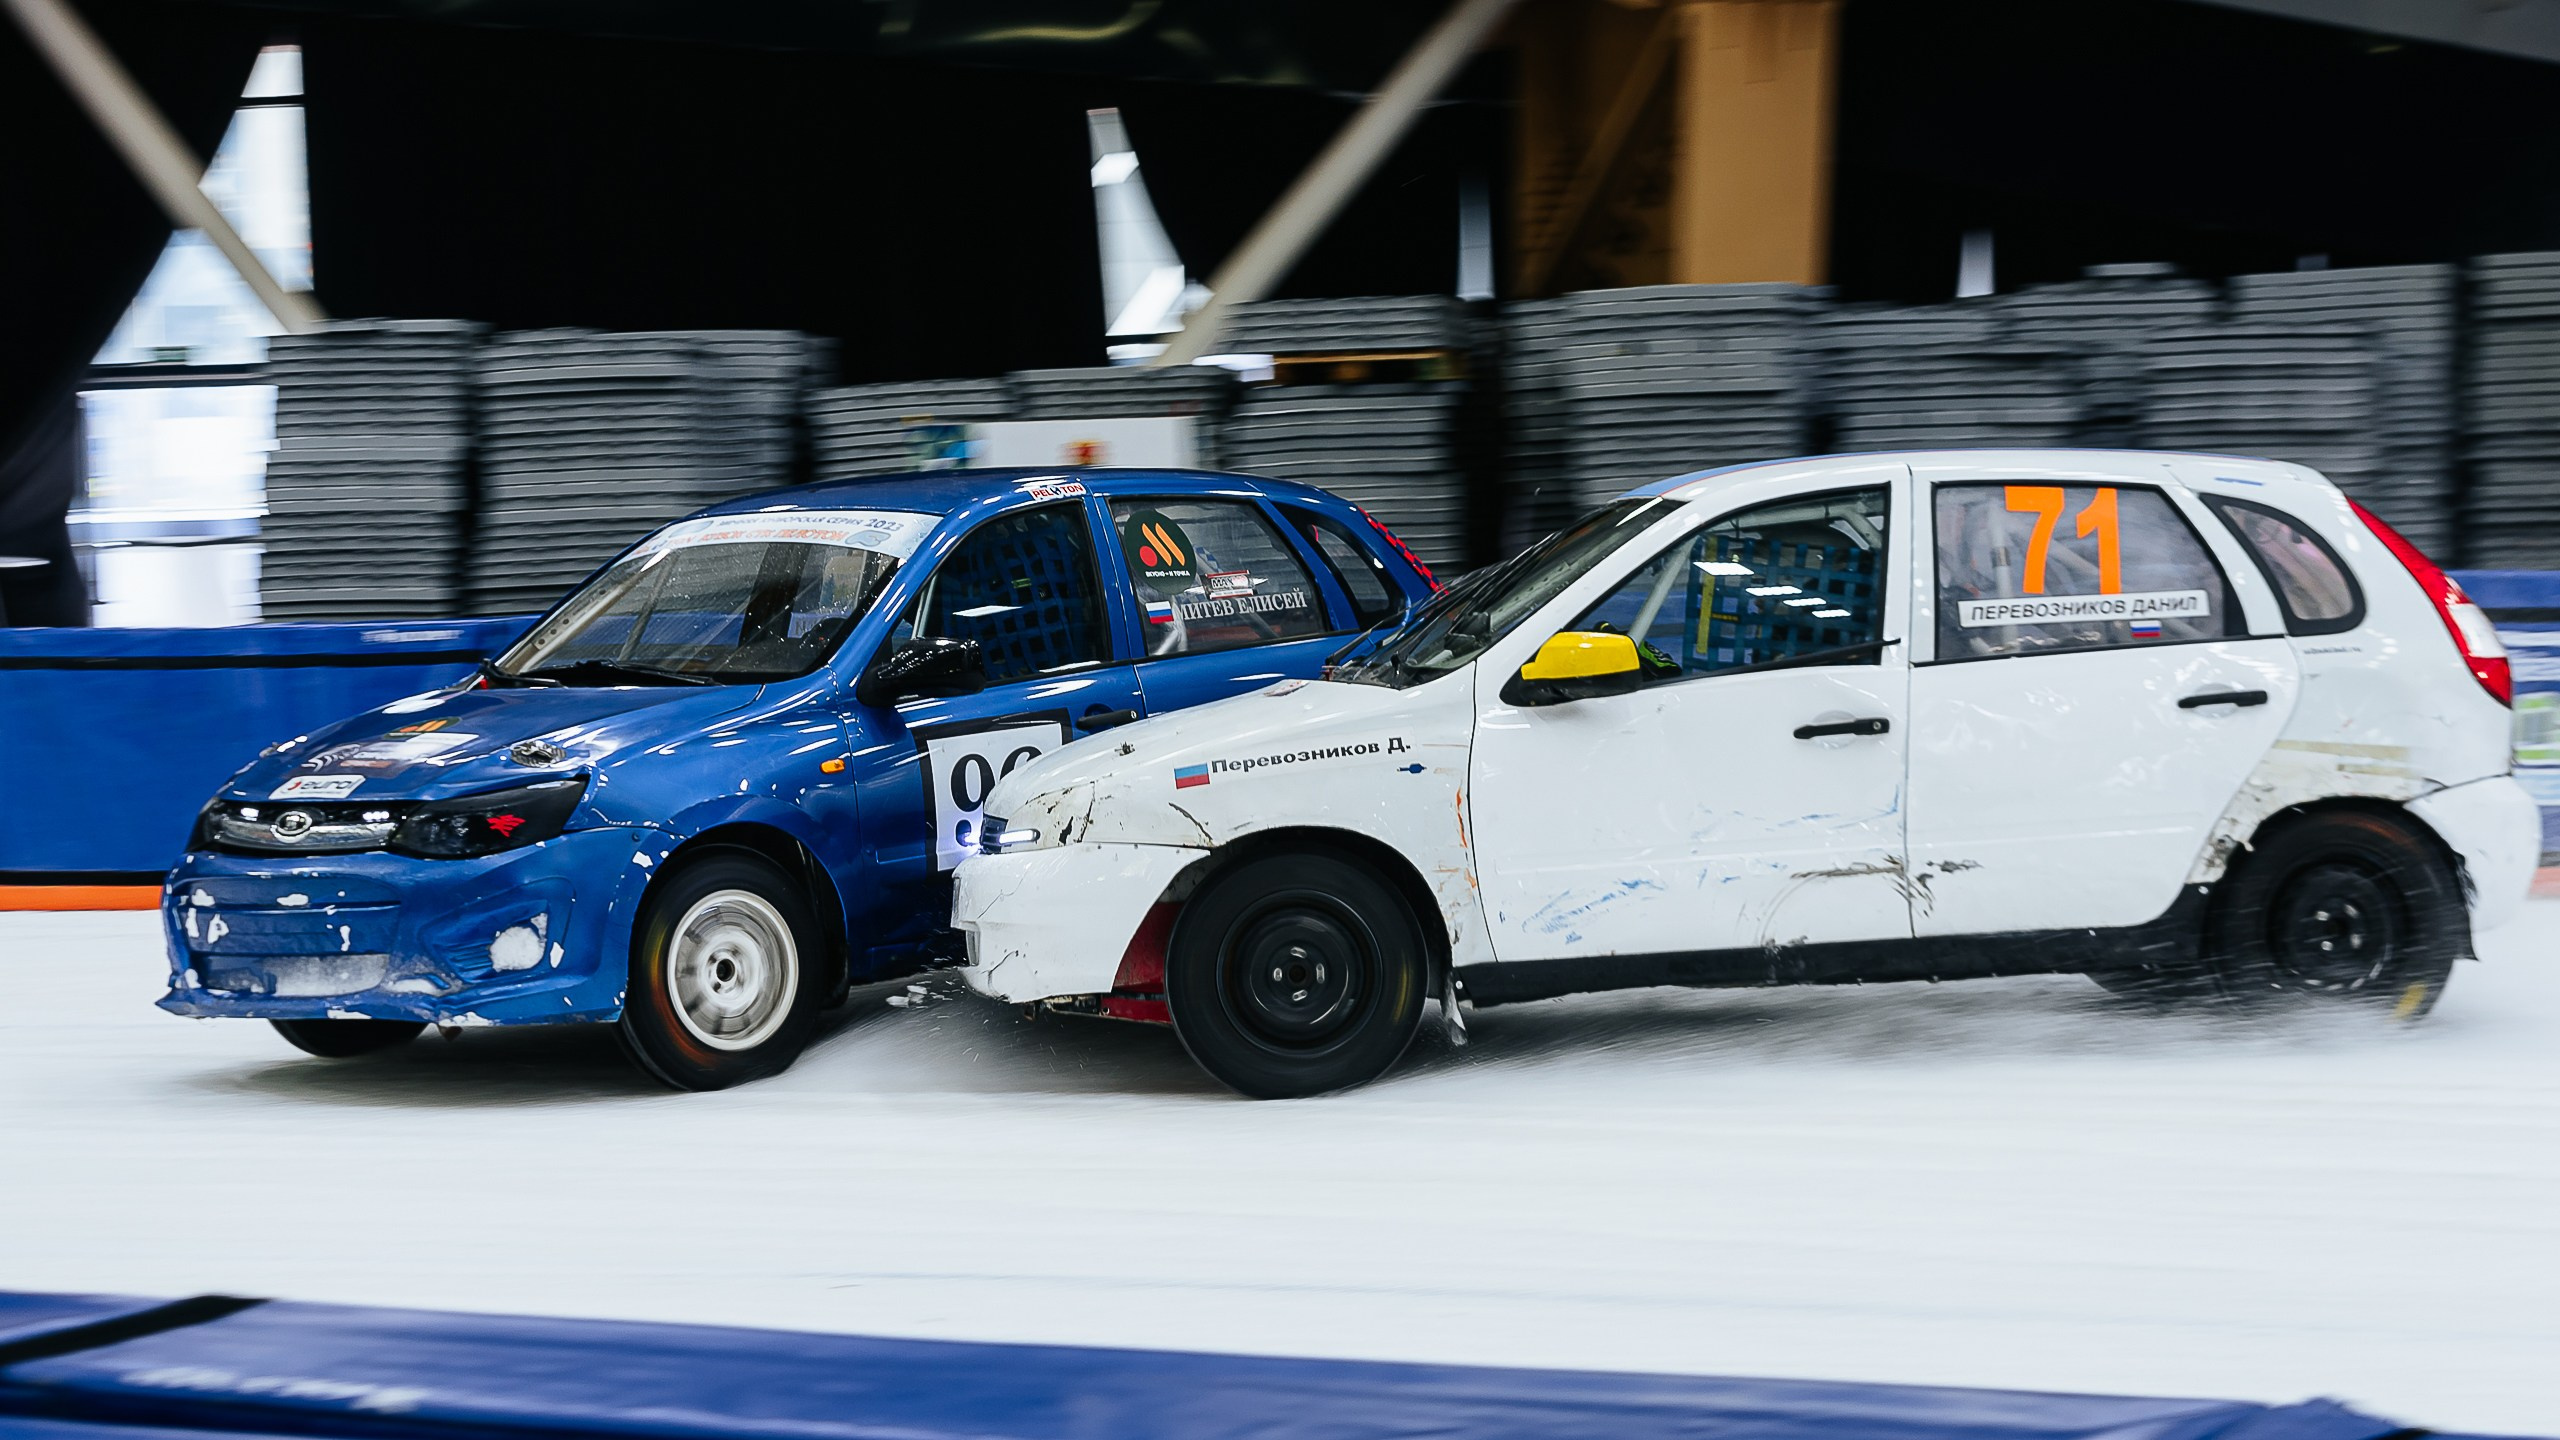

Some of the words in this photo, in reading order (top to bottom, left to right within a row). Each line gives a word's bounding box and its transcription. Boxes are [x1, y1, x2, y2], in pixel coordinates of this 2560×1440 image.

[864, 517, 905, 532] 2023
[2004, 485, 2121, 595] 71
[1238, 587, 1308, 614] ЕЛИСЕЙ
[1971, 599, 2126, 621] ПЕРЕВОЗНИКОВ
[2130, 595, 2198, 617] ДАНИЛ
[1211, 742, 1380, 773] Перевозников
[1387, 736, 1411, 754] Д.
